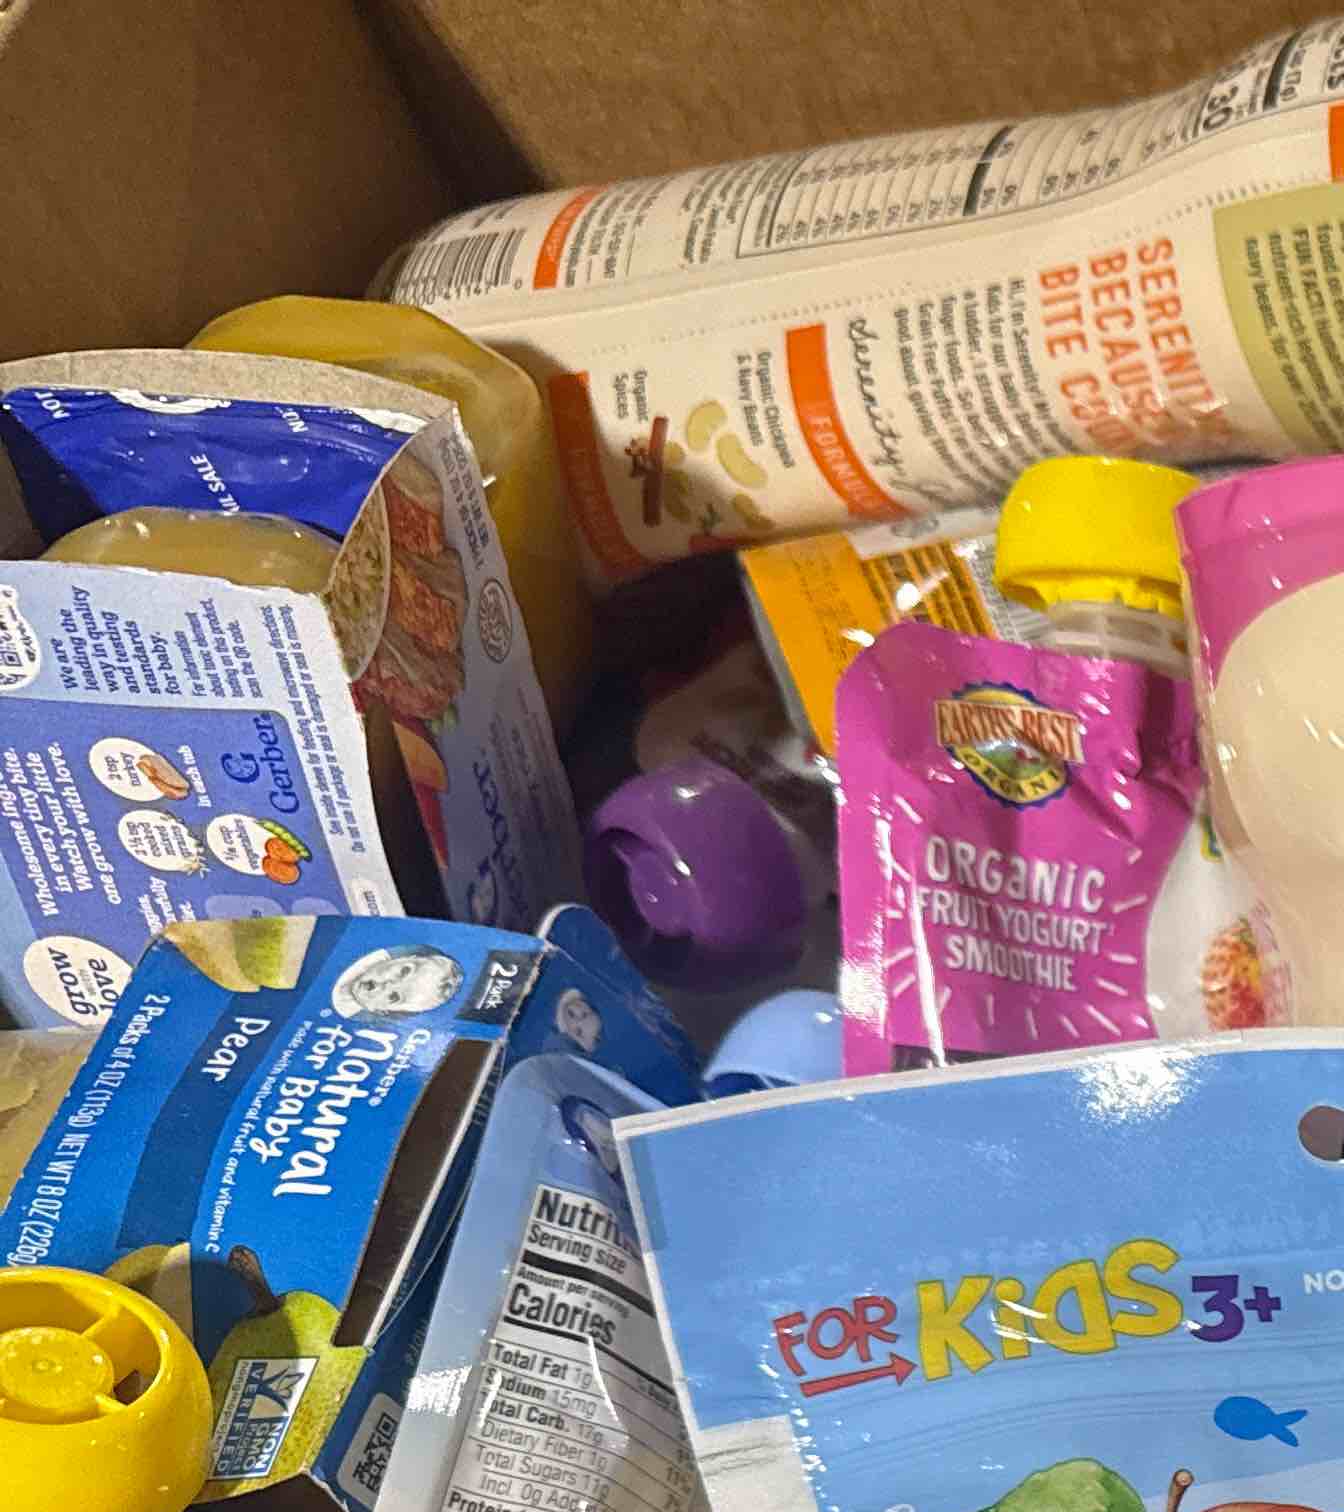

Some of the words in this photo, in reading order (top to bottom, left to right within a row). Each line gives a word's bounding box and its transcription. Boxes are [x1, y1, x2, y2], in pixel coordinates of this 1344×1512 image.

[1039, 266, 1088, 356] BITE
[755, 350, 773, 402] Organic
[60, 609, 78, 632] the
[72, 586, 103, 640] quality
[47, 635, 68, 662] are
[92, 643, 106, 657] in
[101, 611, 128, 662] testing
[121, 618, 162, 696] standards
[150, 631, 172, 670] baby.
[60, 661, 78, 689] We
[66, 634, 101, 694] leading
[99, 661, 119, 692] way
[119, 664, 141, 696] and
[161, 671, 183, 698] for
[1018, 706, 1084, 762] BEST
[917, 884, 996, 934] FRUIT
[999, 906, 1108, 956] YOGURT
[48, 948, 97, 1016] grow
[944, 934, 1077, 992] SMOOTHIE
[144, 992, 170, 1007] 2
[119, 1006, 161, 1044] Packs
[111, 1042, 136, 1061] of
[202, 1016, 271, 1083] Pear
[303, 1024, 350, 1070] for
[96, 1066, 121, 1093] OZ
[67, 1089, 109, 1127] (113g)
[251, 1077, 320, 1163] Baby
[273, 1028, 398, 1198] Natural
[55, 1126, 88, 1159] NET
[39, 1180, 62, 1199] 8
[42, 1156, 73, 1186] WT
[28, 1198, 61, 1219] OZ
[525, 1226, 594, 1264] Serving
[592, 1245, 627, 1273] size
[504, 1283, 620, 1344] Calories
[772, 1295, 897, 1375] FOR
[1191, 1274, 1281, 1343] 3+
[491, 1345, 538, 1372] Total
[538, 1356, 569, 1380] Fat
[255, 1421, 284, 1469] NON
